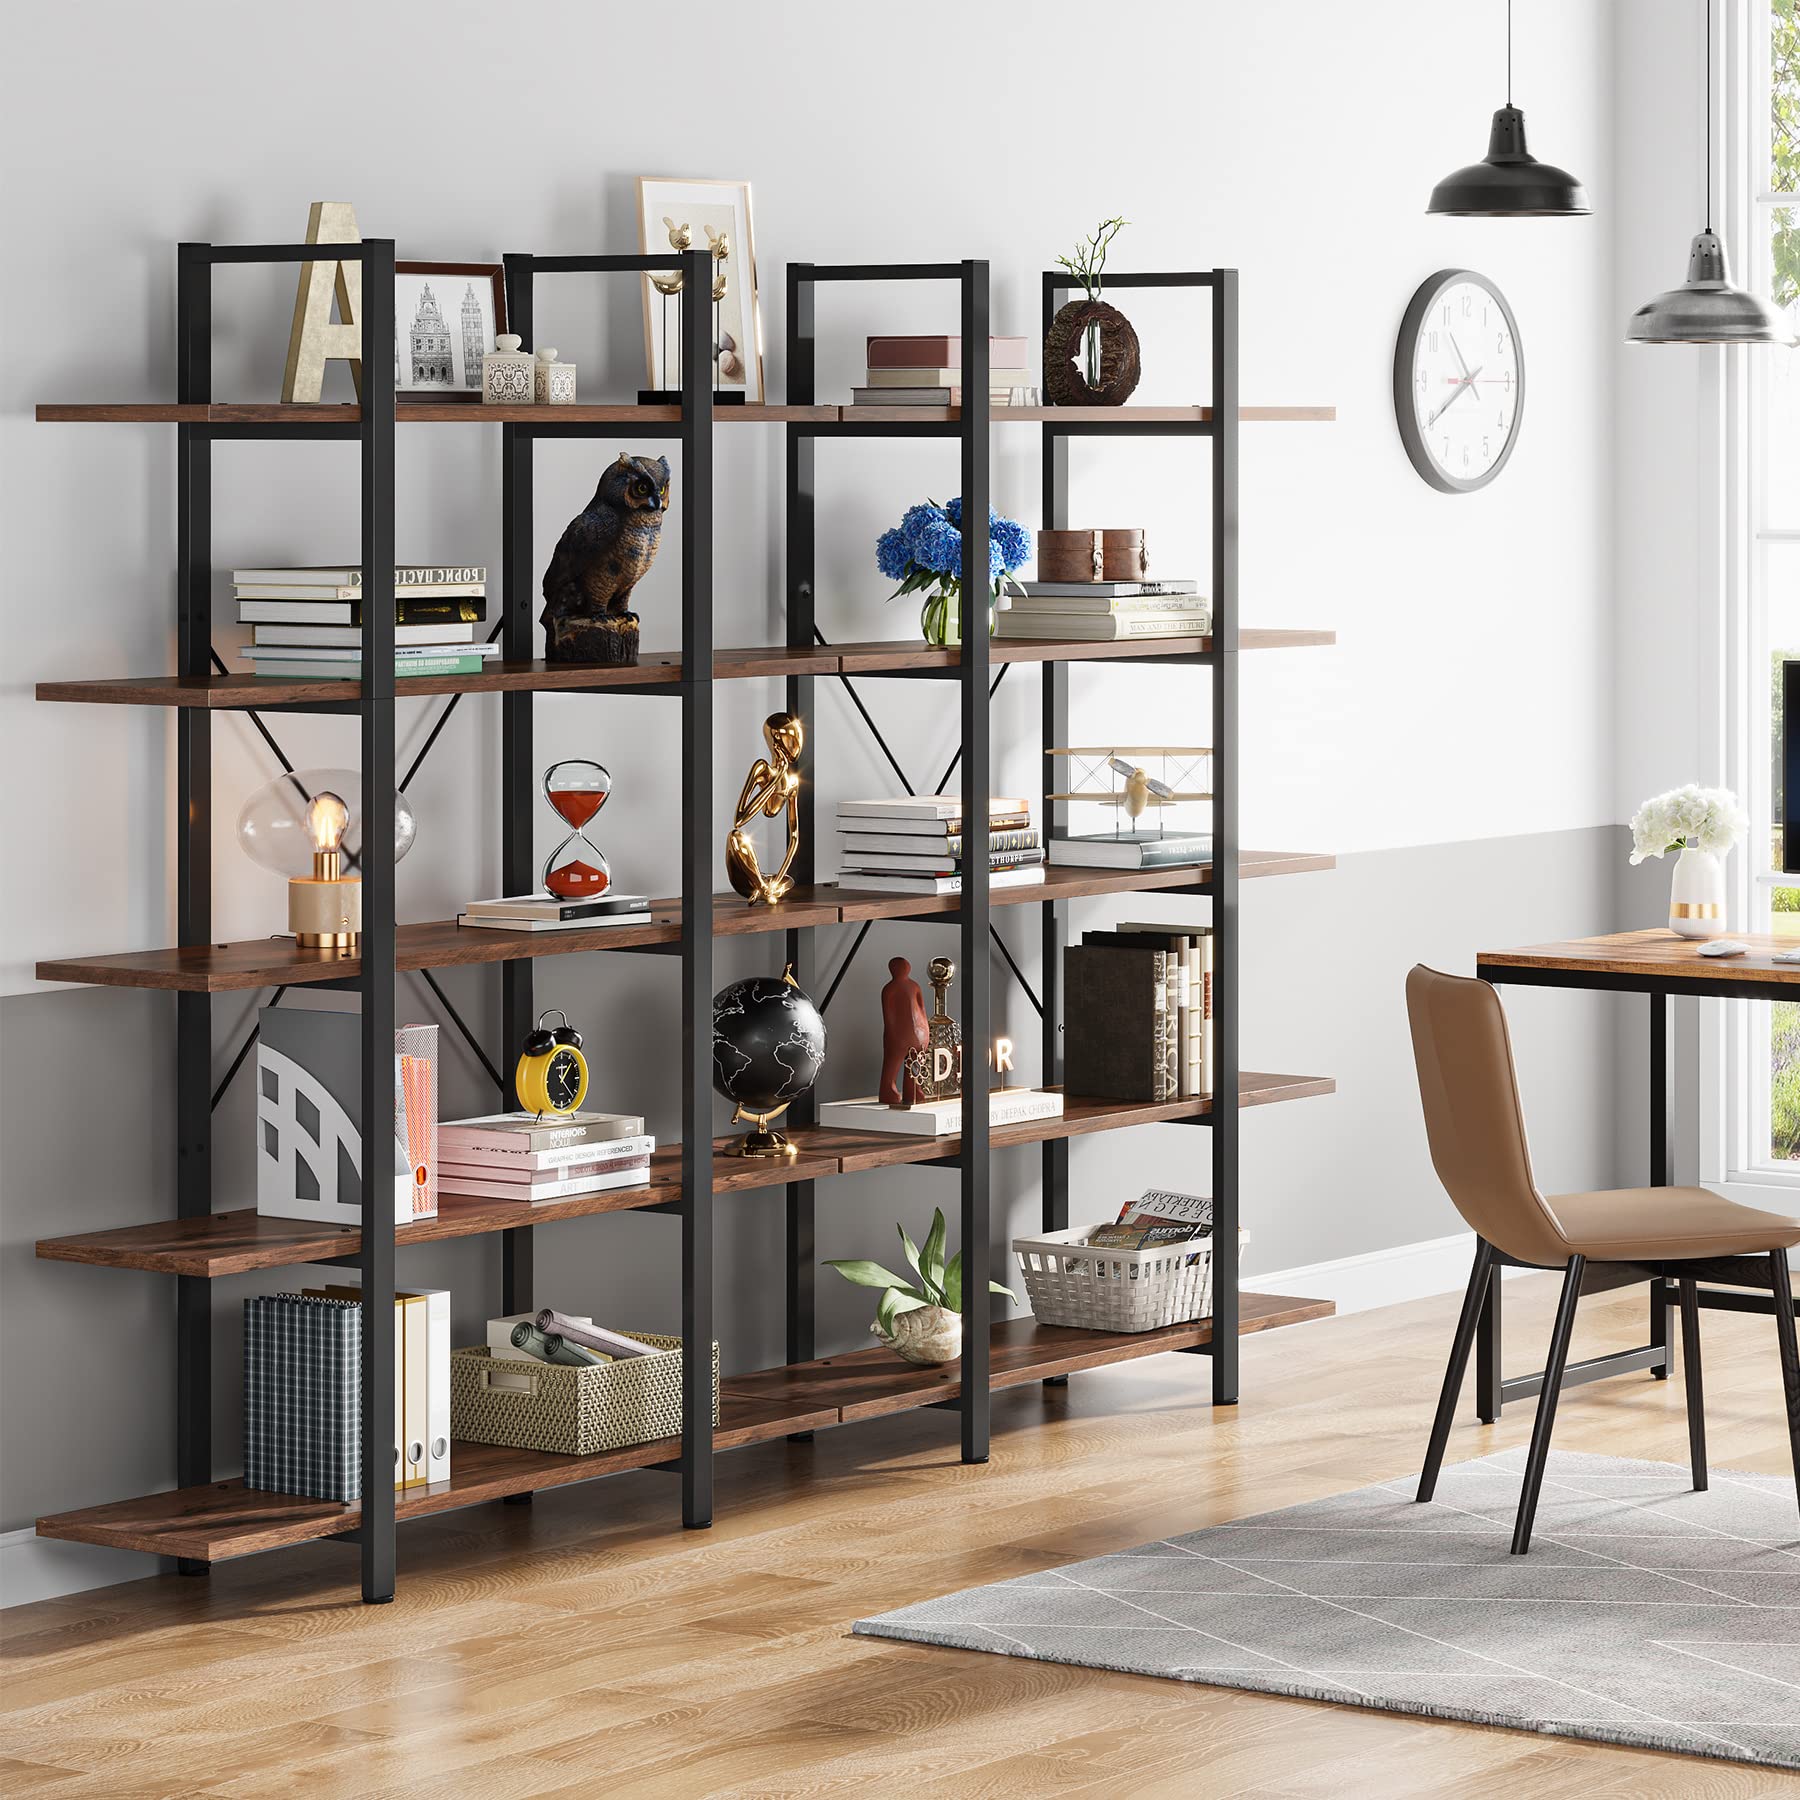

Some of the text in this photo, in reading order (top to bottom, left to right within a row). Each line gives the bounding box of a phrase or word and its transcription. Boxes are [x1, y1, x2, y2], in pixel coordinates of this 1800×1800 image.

[1443, 306, 1451, 327] 11
[1461, 296, 1472, 317] 12
[1483, 307, 1488, 328] 1
[1428, 331, 1438, 353] 10
[1497, 332, 1504, 354] 2
[1421, 370, 1427, 392] 9
[1504, 371, 1511, 392] 3
[1497, 410, 1504, 430] 4
[1443, 436, 1449, 457] 7
[1462, 445, 1469, 465] 6
[1483, 436, 1489, 457] 5
[436, 568, 478, 584] БОРИС
[1130, 623, 1146, 632] MAN
[1179, 621, 1205, 629] FUTURE
[989, 853, 1024, 866] ETHORPE
[934, 1038, 1014, 1082] DIR
[550, 1127, 587, 1138] INTERIORS
[548, 1145, 633, 1163] GRAPHIC DESIGN REFERENCED
